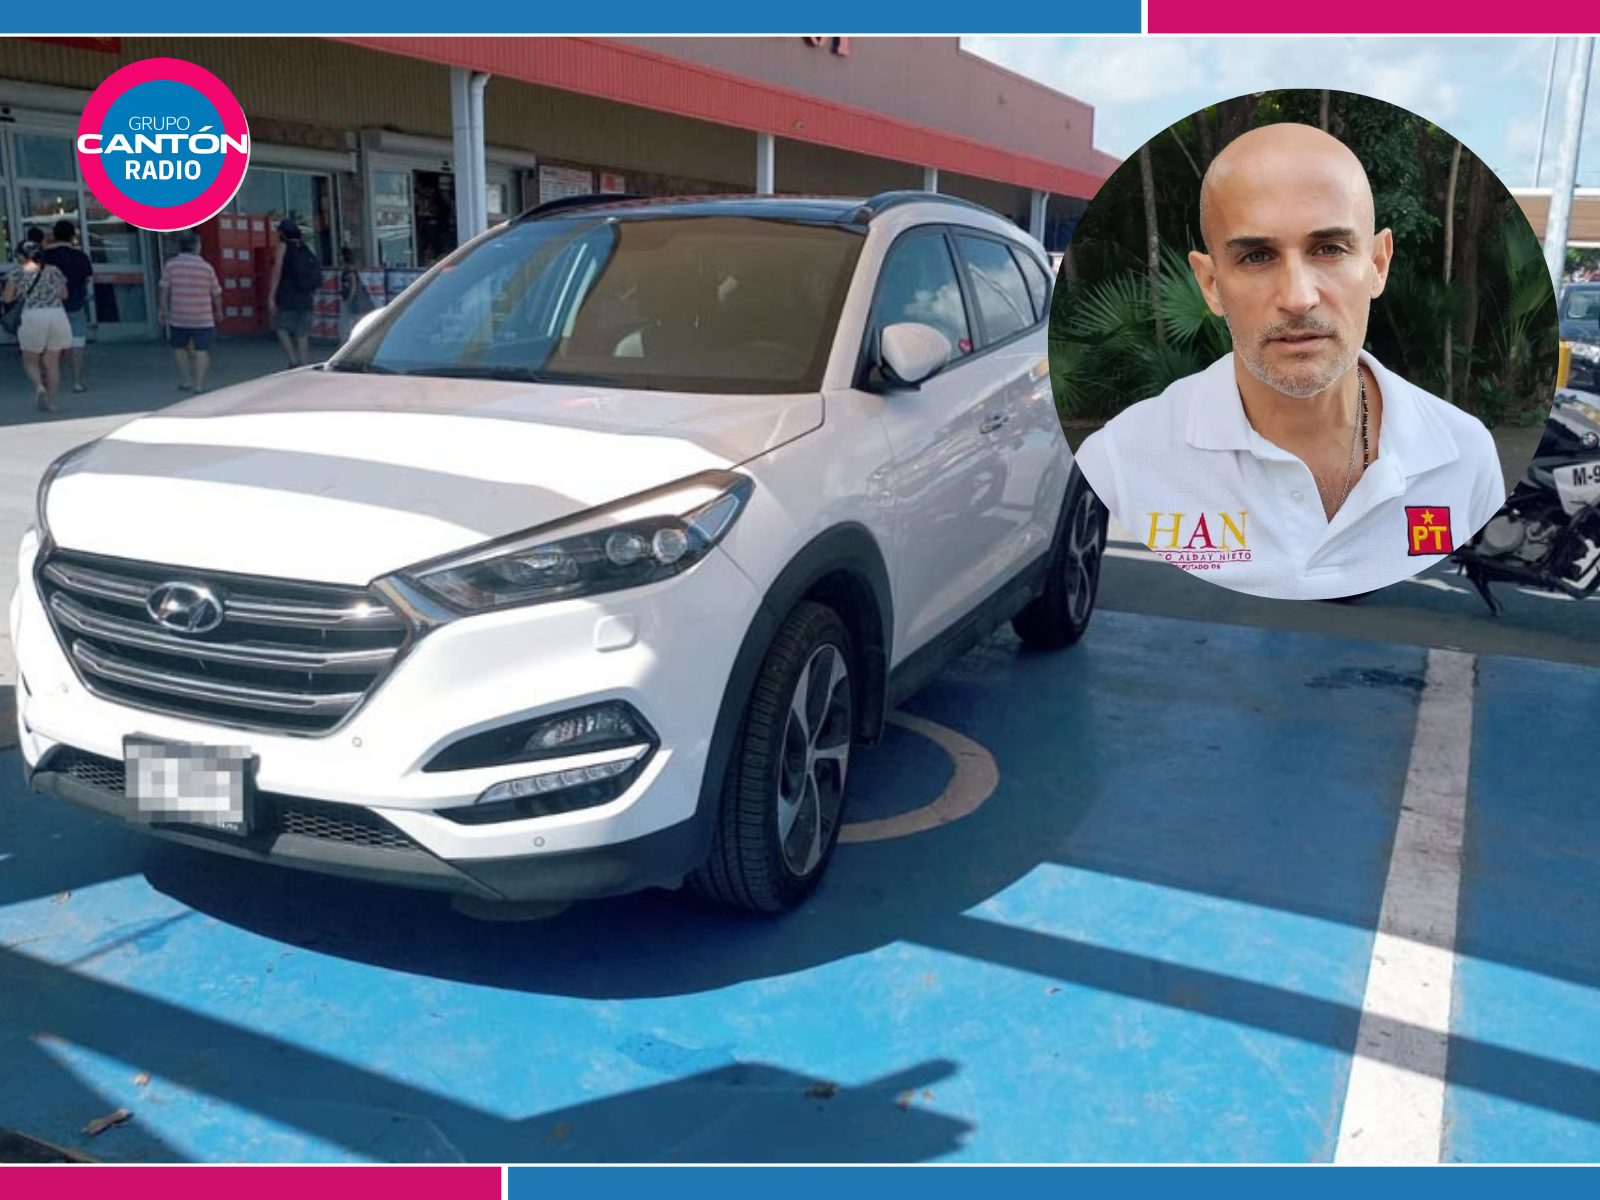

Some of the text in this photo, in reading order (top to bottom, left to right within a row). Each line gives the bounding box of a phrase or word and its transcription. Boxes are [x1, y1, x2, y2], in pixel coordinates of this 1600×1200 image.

[1146, 510, 1249, 550] HAN
[1412, 525, 1447, 551] PT
[1179, 552, 1214, 561] ALDAY
[1219, 552, 1252, 561] NIETO
